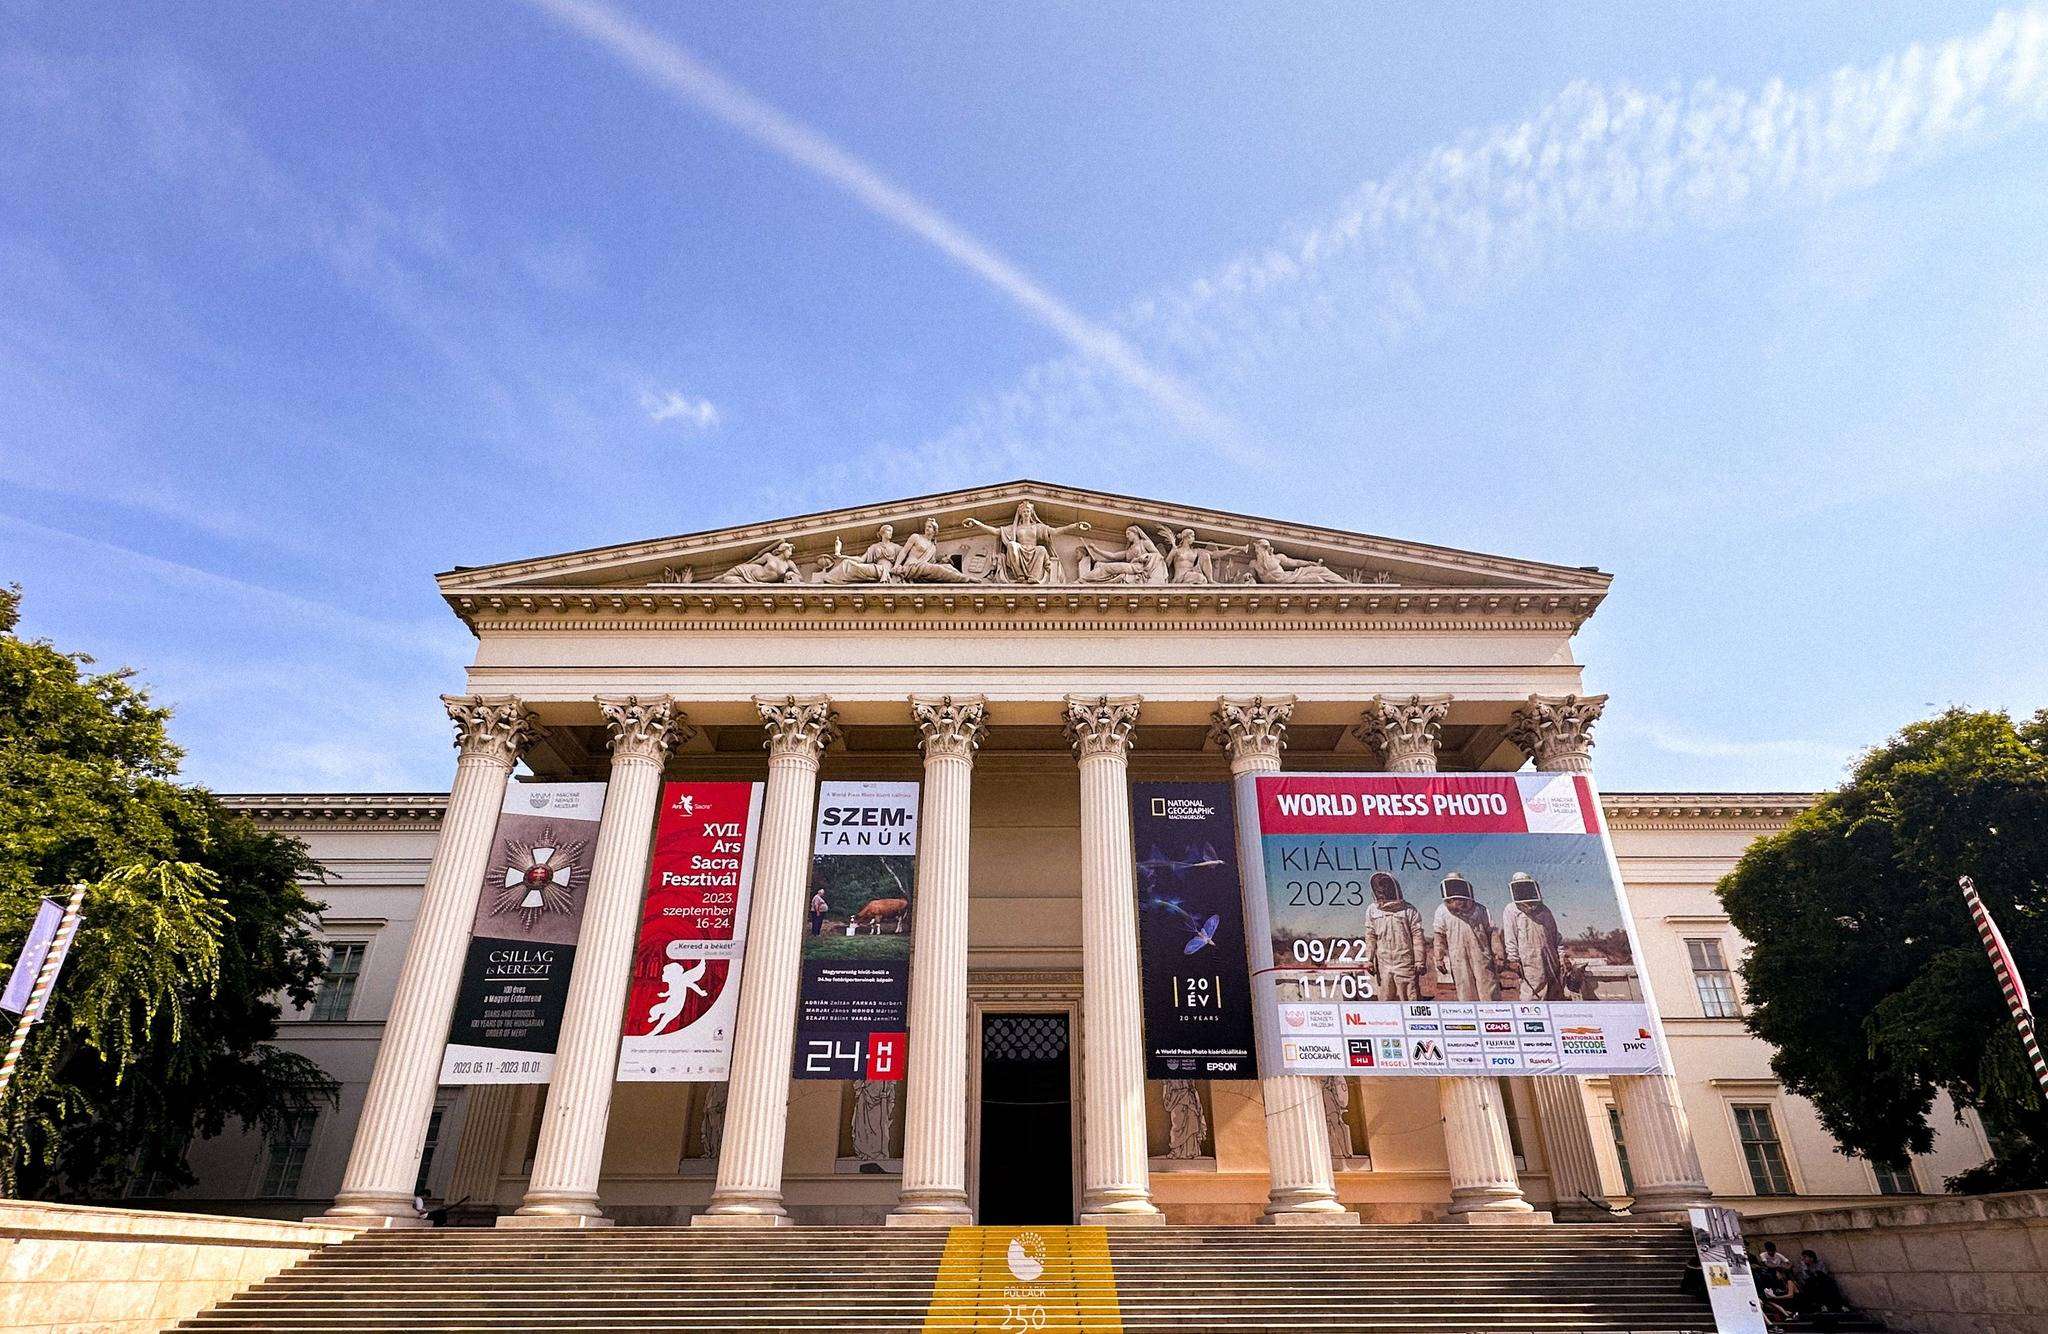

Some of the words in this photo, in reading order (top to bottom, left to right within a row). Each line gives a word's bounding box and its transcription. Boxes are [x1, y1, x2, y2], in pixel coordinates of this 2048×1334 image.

[1167, 799, 1204, 807] NATIONAL
[1276, 793, 1357, 816] WORLD
[1361, 793, 1430, 816] PRESS
[1432, 793, 1508, 816] PHOTO
[822, 807, 913, 826] SZEM-
[1167, 807, 1215, 815] GEOGRAPHIC
[702, 823, 742, 837] XVII.
[820, 828, 911, 846] TANÚK
[712, 840, 741, 853] Ars
[1281, 840, 1442, 871] KIÁLLÍTÁS
[690, 855, 739, 870] Sacra
[662, 871, 737, 886] Fesztivál
[702, 892, 734, 904] 2023.
[1286, 881, 1364, 906] 2023
[662, 906, 734, 918] szeptember
[696, 918, 732, 928] 16-24.
[489, 950, 554, 962] CSILLAG
[1293, 939, 1369, 962] 09/22
[496, 964, 552, 974] KERESZT
[1186, 978, 1208, 990] 20
[1300, 975, 1374, 998] 11/05
[1188, 992, 1210, 1007] ÉV
[1346, 1013, 1366, 1026] NL
[1350, 1042, 1370, 1053] 24
[1562, 1040, 1606, 1048] POSTCODE
[1622, 1042, 1646, 1052] pwc
[1206, 1062, 1236, 1070] EPSON
[1003, 1286, 1046, 1298] POLLACK
[1000, 1304, 1046, 1334] 250
